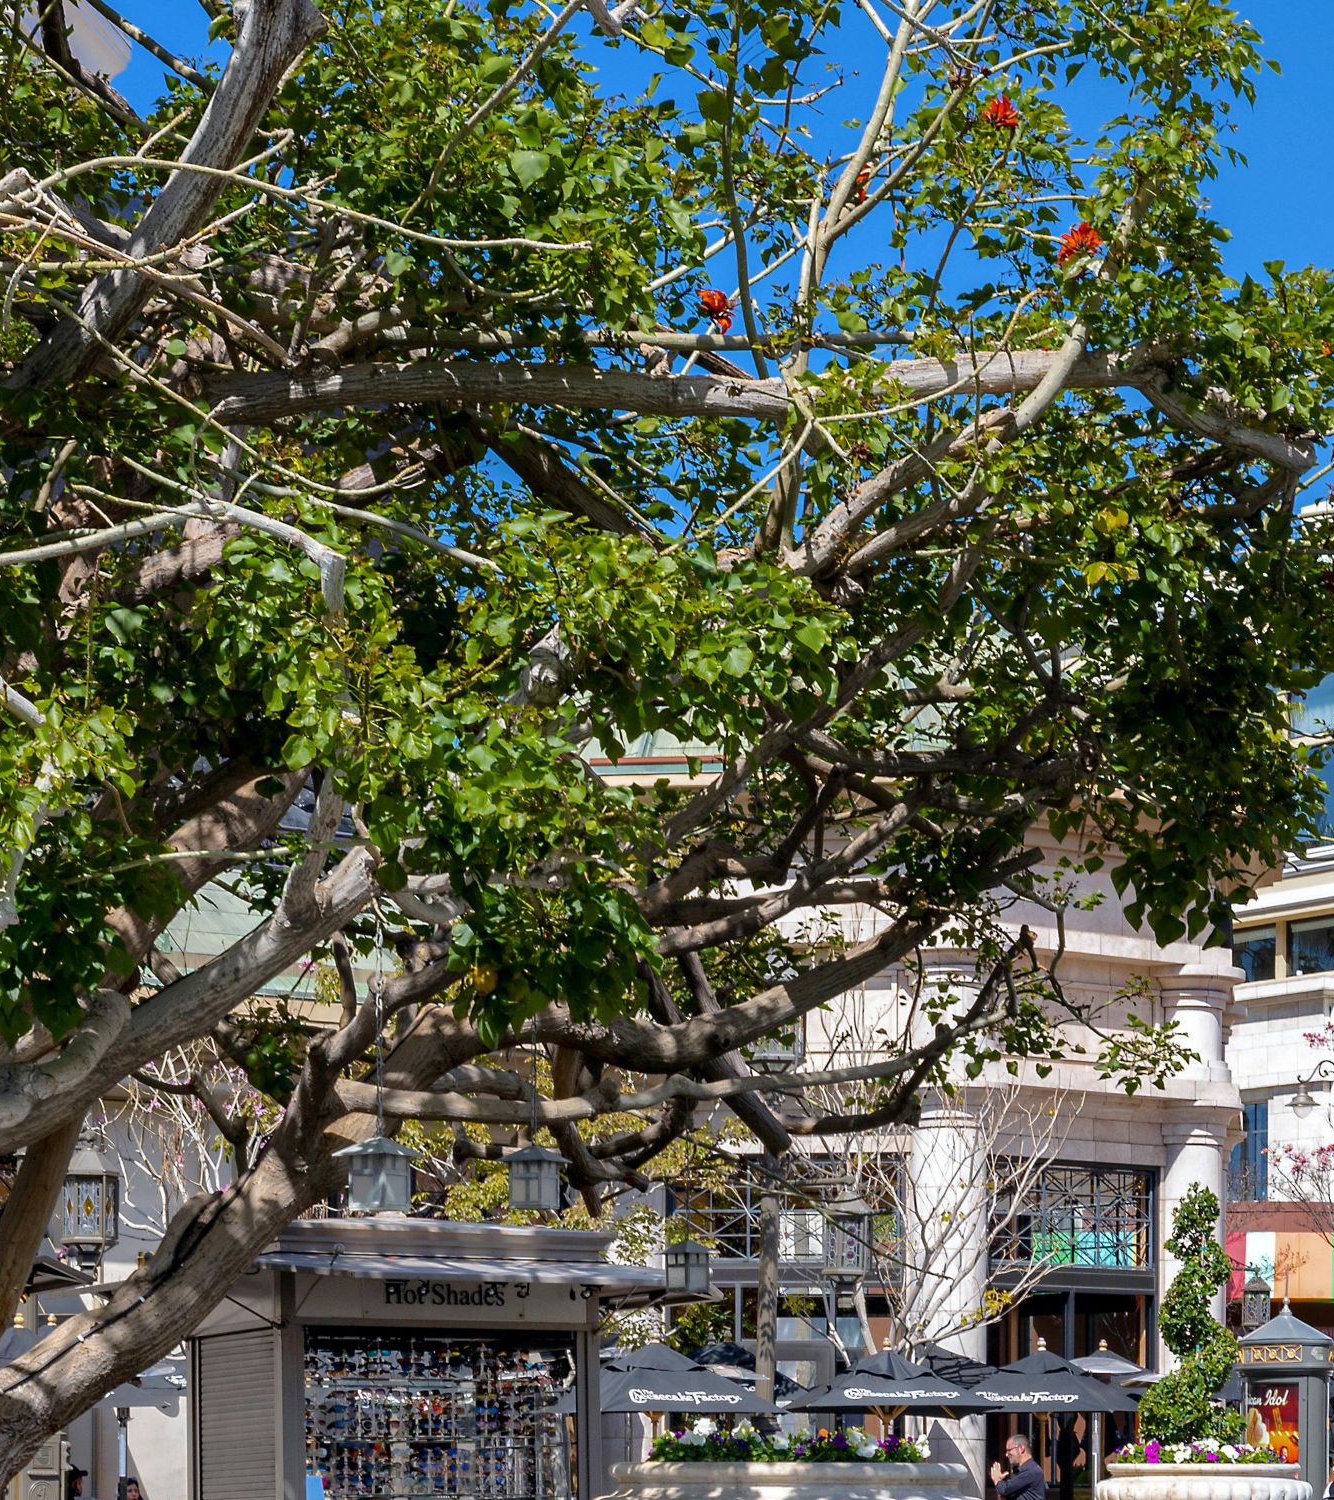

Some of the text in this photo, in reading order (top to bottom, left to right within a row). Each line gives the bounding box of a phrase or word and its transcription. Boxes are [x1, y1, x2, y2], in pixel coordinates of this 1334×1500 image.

[384, 1281, 505, 1306] Hot Shades
[1263, 1388, 1289, 1406] Idol
